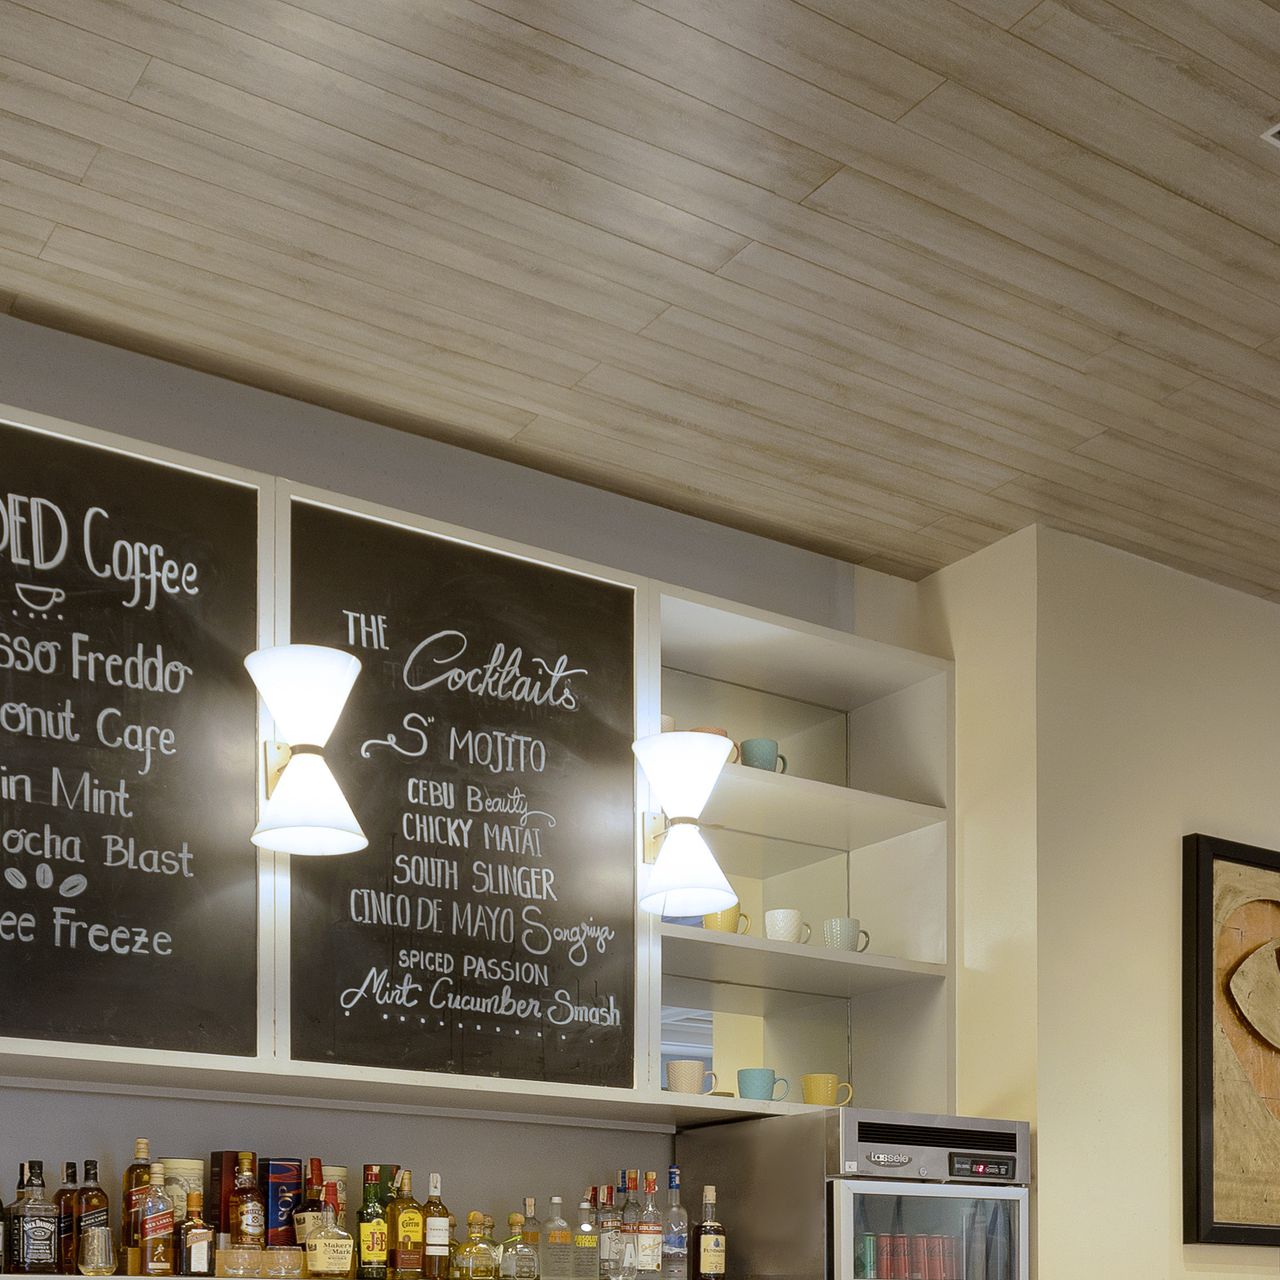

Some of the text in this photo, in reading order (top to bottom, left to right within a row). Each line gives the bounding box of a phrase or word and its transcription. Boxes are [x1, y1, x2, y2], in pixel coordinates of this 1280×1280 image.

[83, 507, 198, 610] Coffee
[343, 609, 390, 650] THE
[72, 633, 193, 694] Freddo
[449, 726, 546, 773] MOJITO
[51, 767, 133, 818] Mint
[407, 777, 557, 828] CEBU Beauty
[104, 835, 194, 878] Blast
[402, 812, 543, 858] CHICKY MATAI
[393, 854, 558, 901] SOUTH SLINGER
[53, 907, 172, 956] Freeze
[350, 888, 411, 928] CINCO
[417, 896, 443, 933] DE
[452, 901, 515, 944] MAYO
[398, 949, 549, 987] SPICED PASSION
[340, 966, 620, 1026] Mint Cucumber Smash
